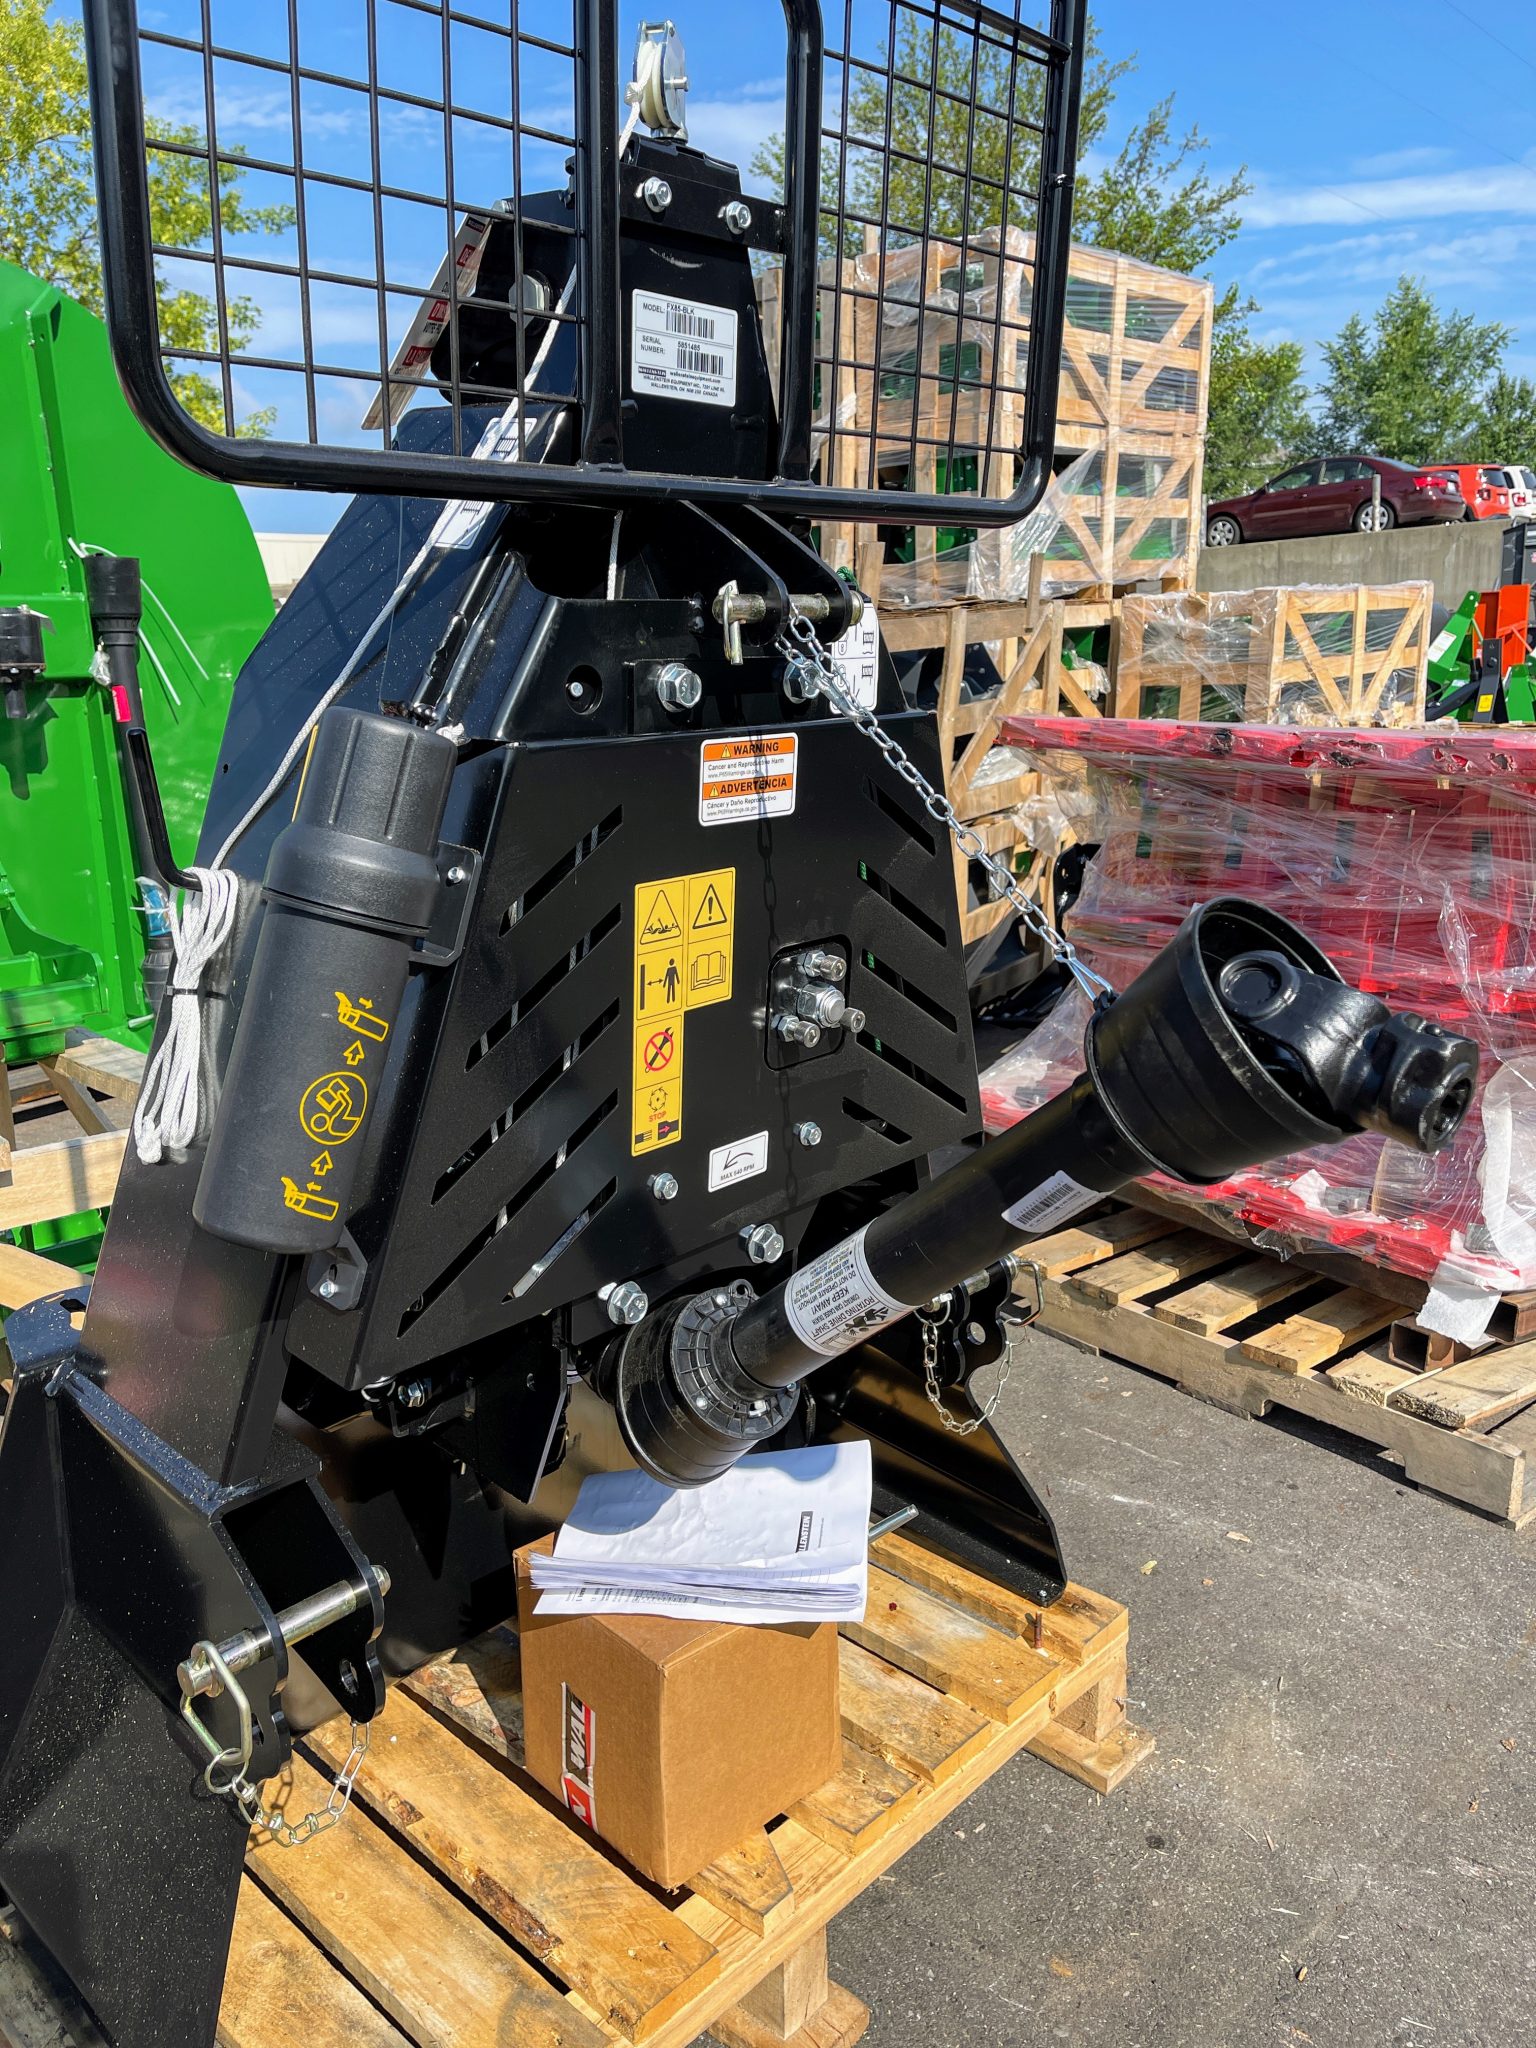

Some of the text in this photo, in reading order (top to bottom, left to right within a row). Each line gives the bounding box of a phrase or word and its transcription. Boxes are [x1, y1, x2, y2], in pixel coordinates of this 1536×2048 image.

[643, 302, 695, 315] MODEL: FX85-BLK
[642, 335, 661, 345] SERIAL
[641, 344, 665, 354] NUMBER:
[733, 742, 779, 755] WARNING
[720, 778, 787, 794] ADVERTENCIA
[648, 1110, 667, 1123] STOP
[720, 1172, 733, 1181] MAX
[743, 1163, 755, 1173] RPM
[837, 1275, 849, 1286] NOT
[847, 1270, 857, 1279] DO
[810, 1286, 850, 1315] KEEP AWAY!
[844, 1295, 875, 1318] ROTATING
[828, 1312, 847, 1328] DRIVE
[811, 1322, 830, 1338] SHAFT
